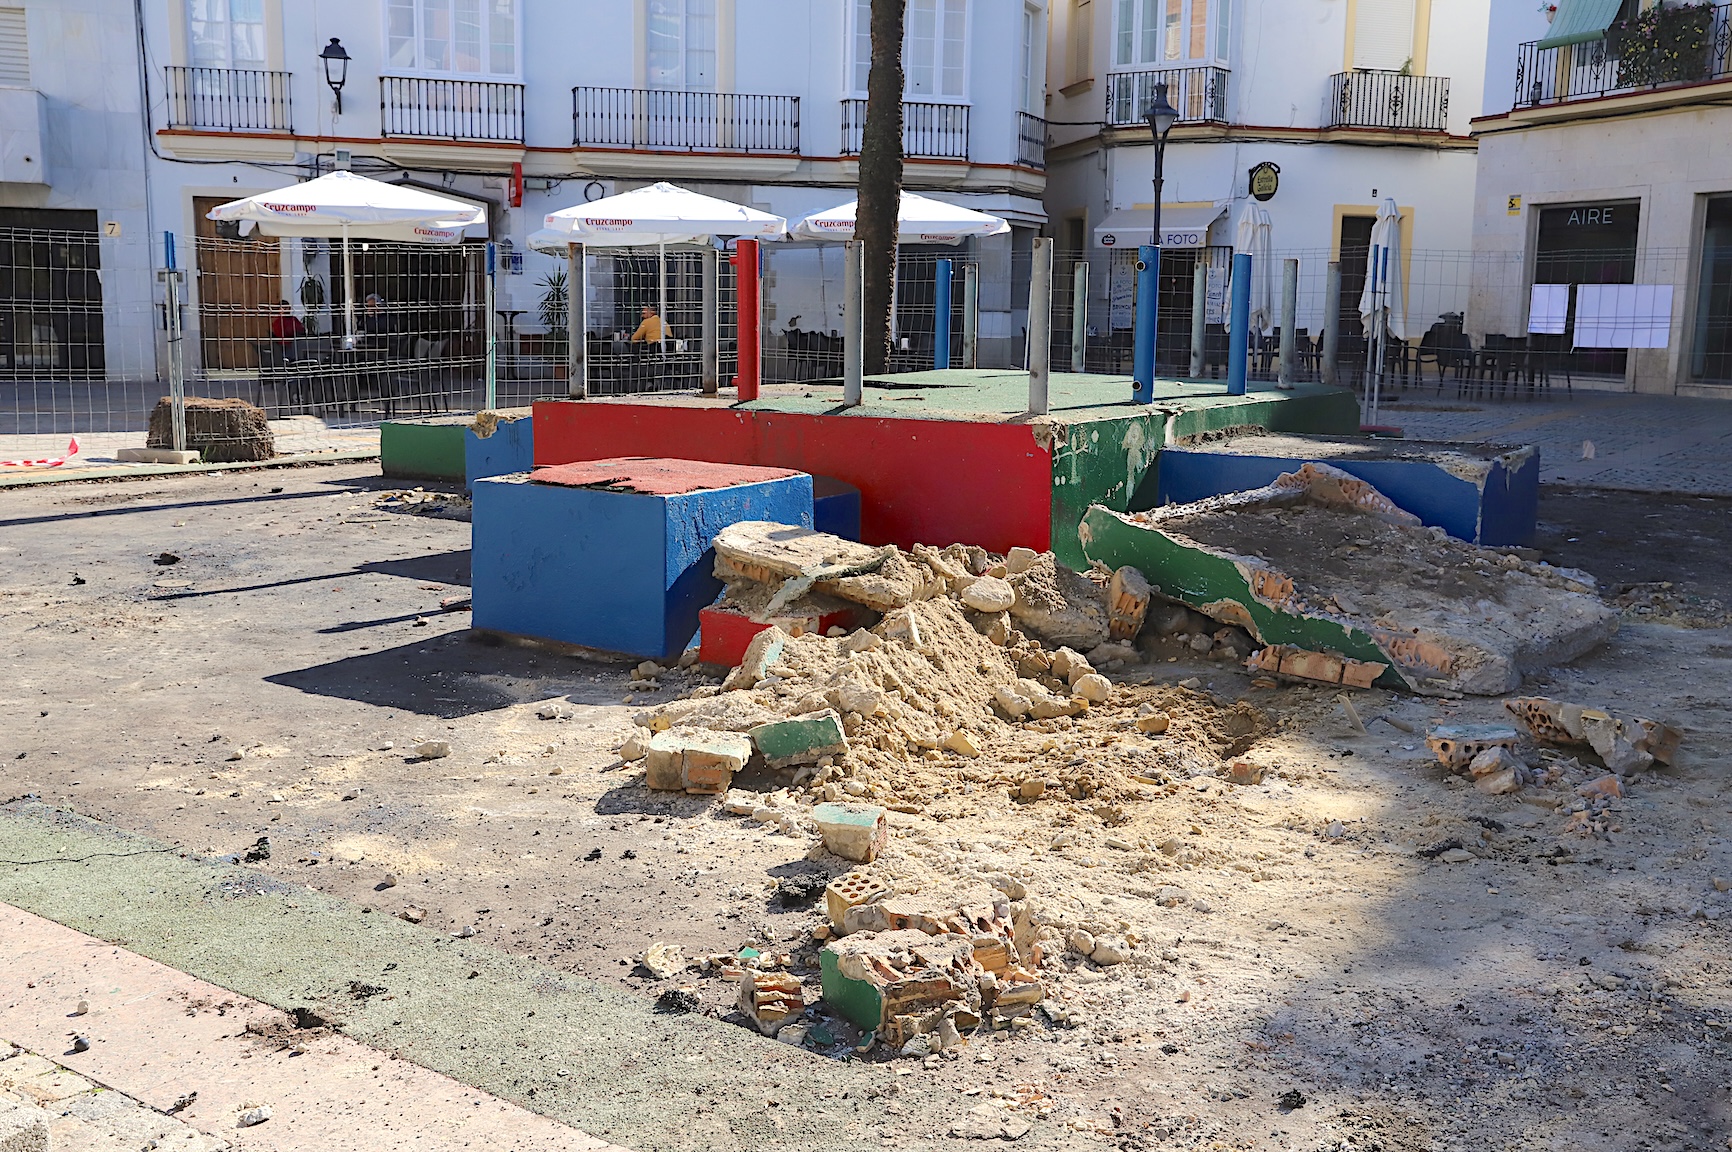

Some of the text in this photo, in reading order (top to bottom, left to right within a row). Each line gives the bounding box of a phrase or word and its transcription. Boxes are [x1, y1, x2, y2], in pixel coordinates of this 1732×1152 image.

[263, 202, 317, 213] Cruzcampo
[1567, 207, 1614, 225] AIRE
[585, 217, 633, 227] Cruzcampo
[814, 219, 856, 228] Cruzcamp
[107, 223, 116, 235] 7
[413, 227, 455, 237] Cruzcampo
[1167, 233, 1198, 245] FOTO
